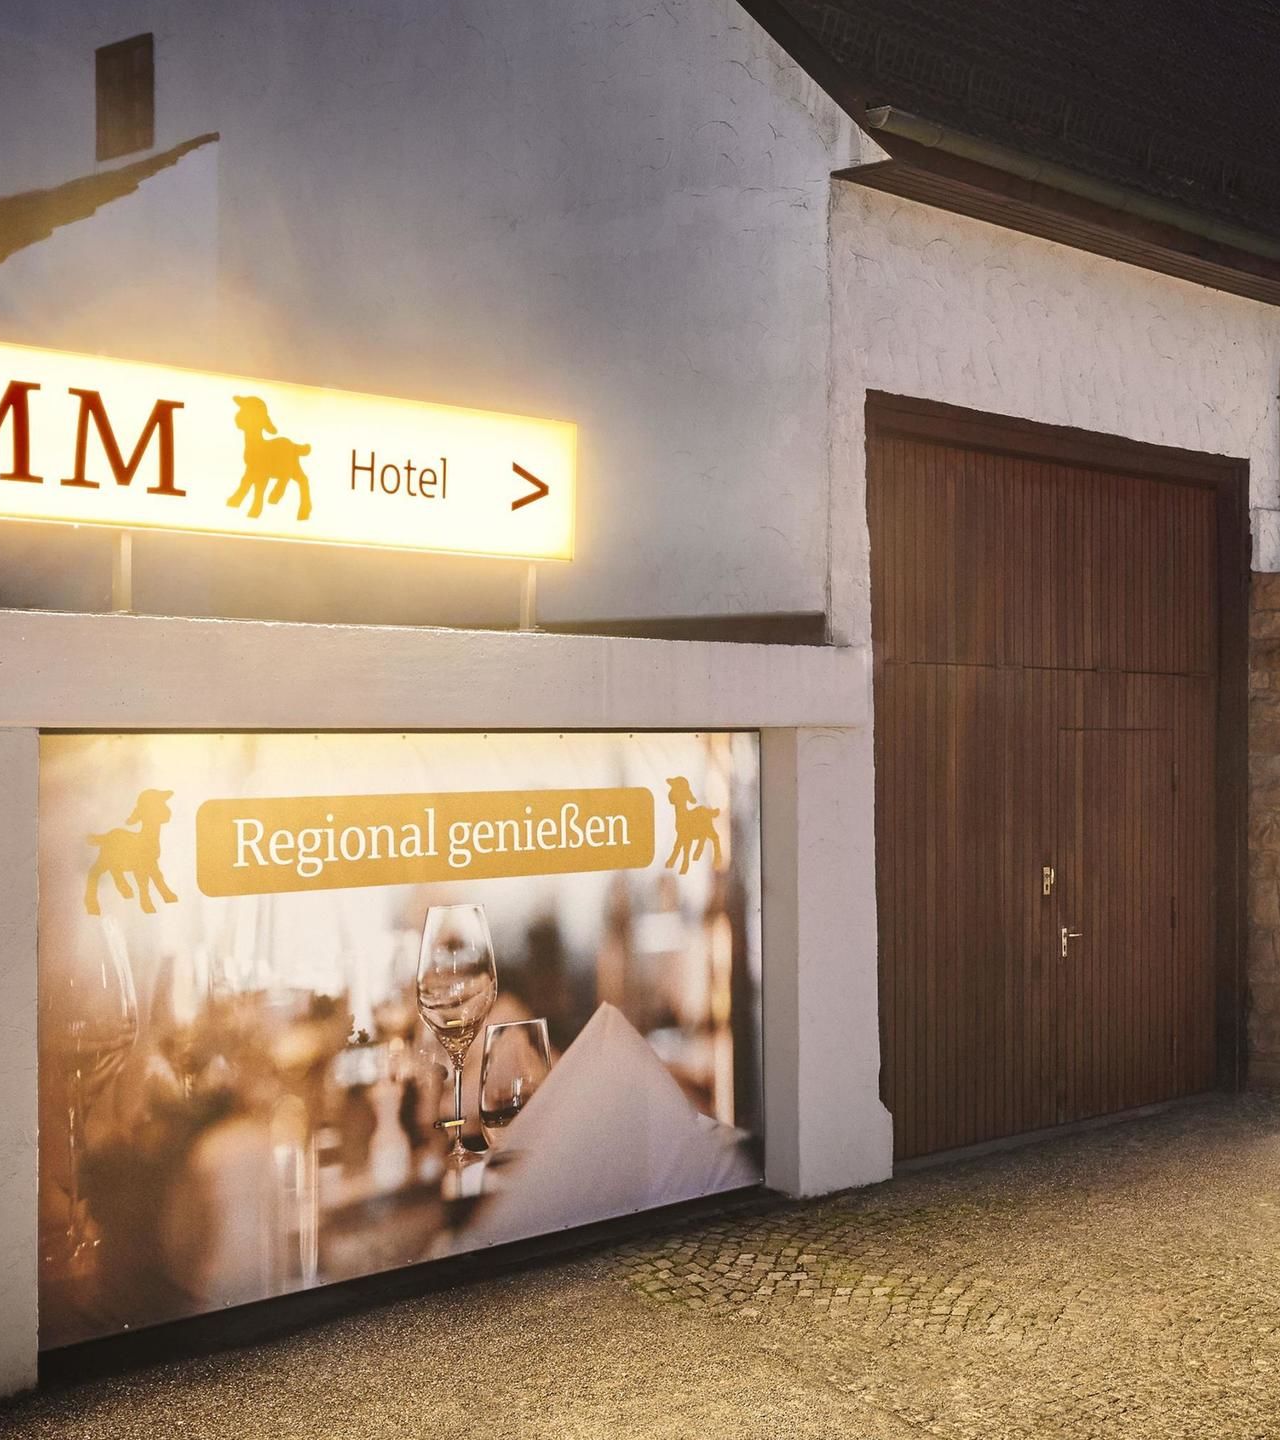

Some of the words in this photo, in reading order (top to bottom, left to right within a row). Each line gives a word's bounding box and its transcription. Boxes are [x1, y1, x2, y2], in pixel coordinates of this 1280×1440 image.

[349, 449, 448, 500] Hotel
[232, 807, 439, 878] Regional
[448, 802, 632, 868] genießen
